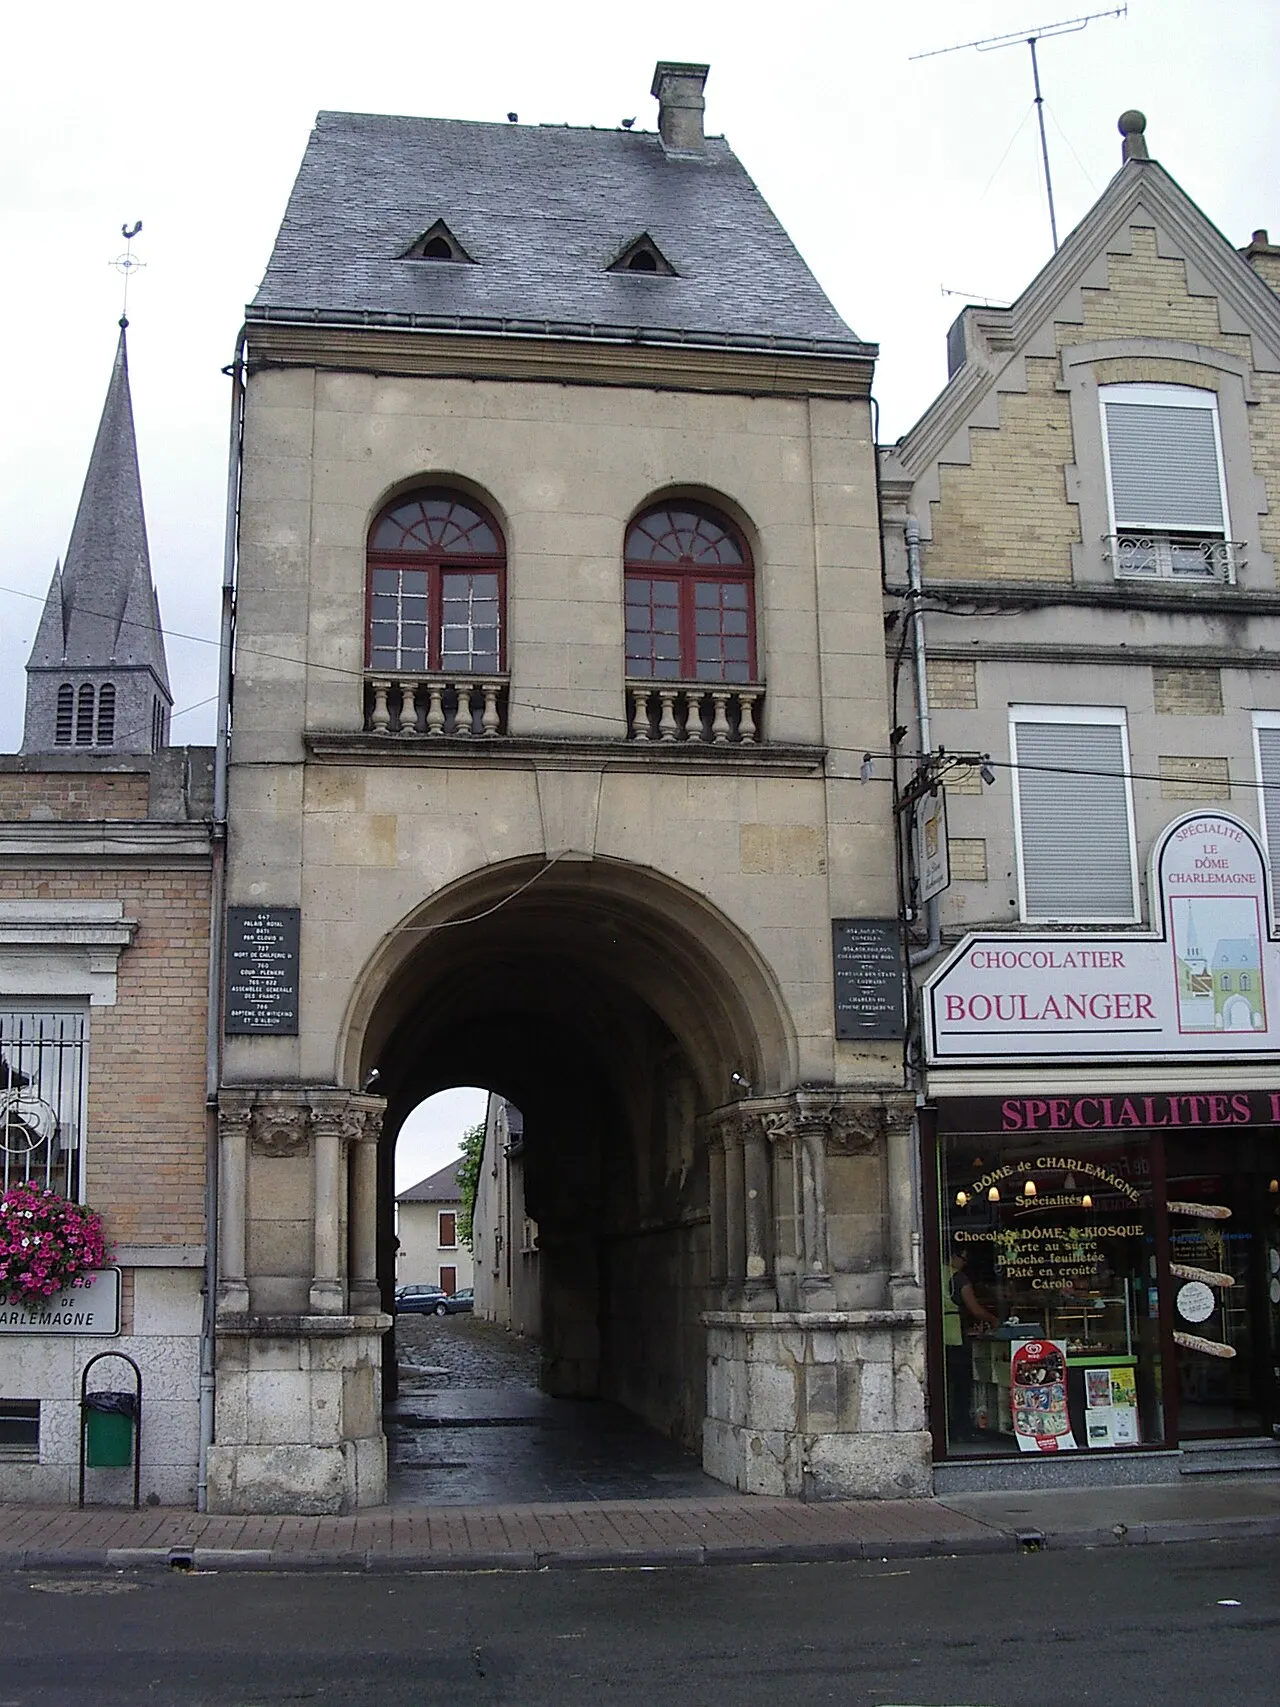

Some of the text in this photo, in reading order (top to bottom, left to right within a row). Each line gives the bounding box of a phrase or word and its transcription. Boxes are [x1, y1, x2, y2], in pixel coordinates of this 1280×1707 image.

[1175, 823, 1244, 843] SPÉCIALITÉ
[1203, 844, 1219, 855] LE
[1194, 856, 1230, 869] DÔME
[1168, 872, 1257, 884] CHARLEMAGNE
[969, 950, 1126, 969] CHOCOLATIER
[944, 993, 1157, 1021] BOULANGER
[1002, 1094, 1252, 1131] SPECIALITES
[972, 1165, 1013, 1193] DÔME
[1017, 1161, 1032, 1172] de
[1036, 1157, 1141, 1202] CHARLEMAGNE
[1015, 1194, 1083, 1208] Spécialités
[1022, 1226, 1064, 1240] DÔME
[1084, 1225, 1145, 1238] KIOSQUE
[1006, 1241, 1098, 1252] Tarte au sucre
[997, 1252, 1105, 1265] Brioche feuilletée
[1006, 1265, 1098, 1278] Pâté en croûte
[1031, 1278, 1074, 1290] Carolo
[61, 1299, 76, 1307] DE
